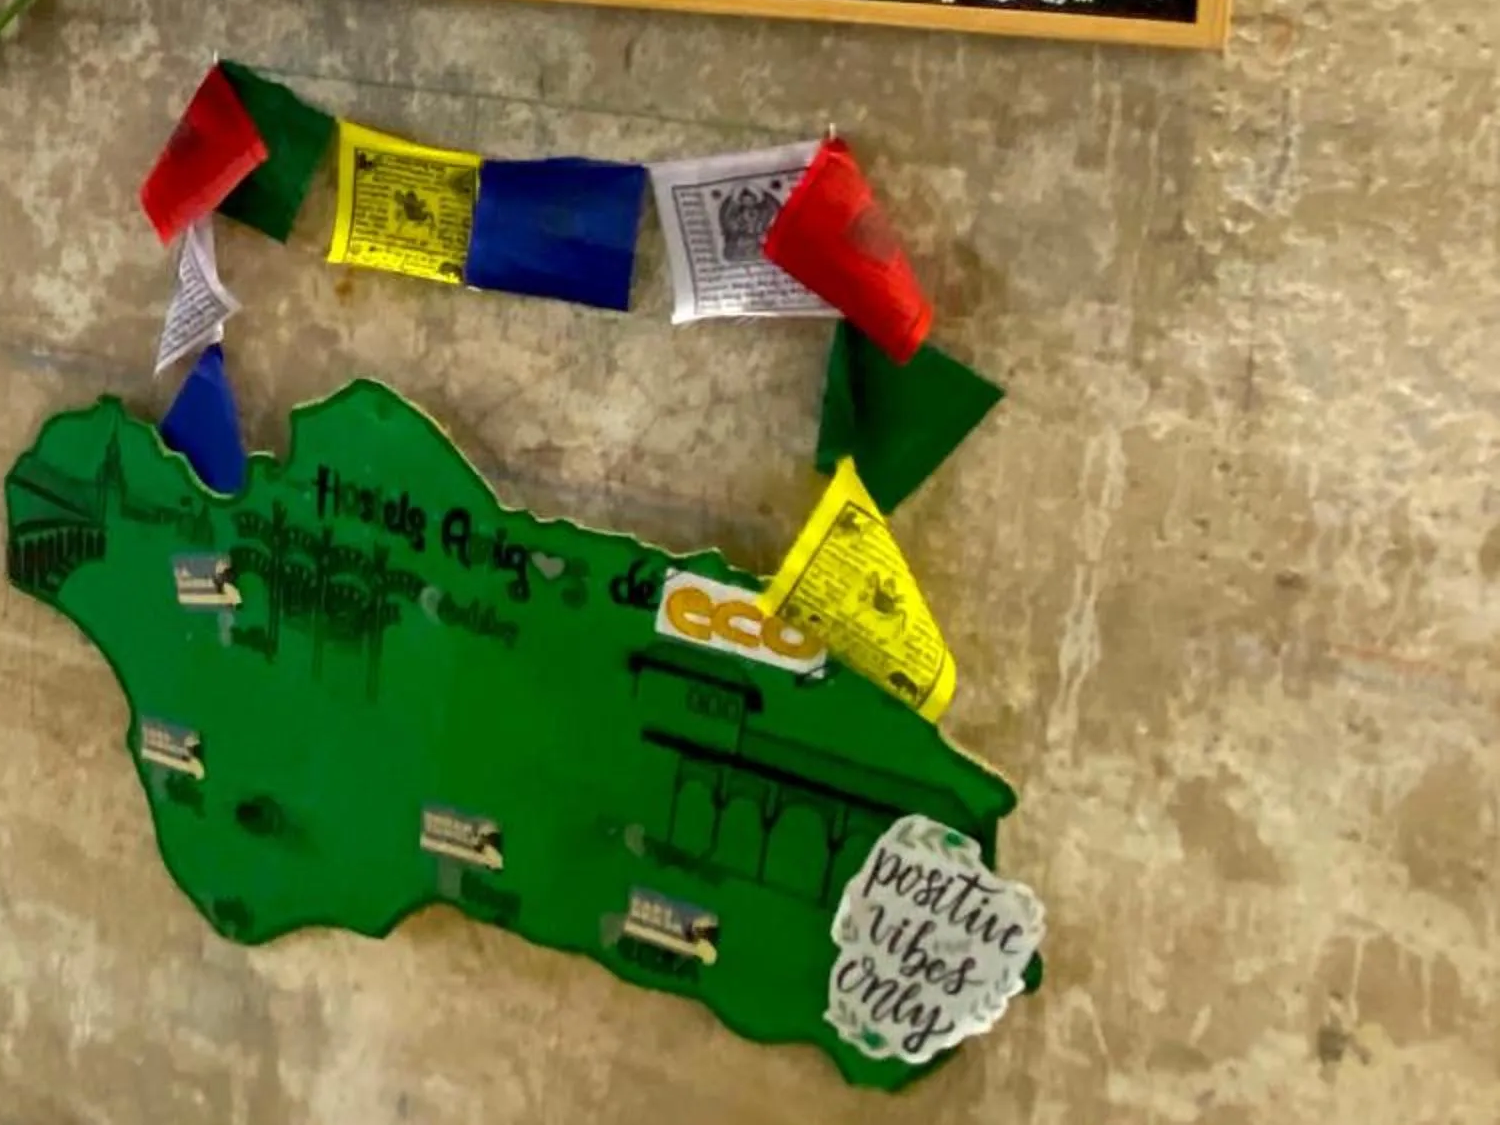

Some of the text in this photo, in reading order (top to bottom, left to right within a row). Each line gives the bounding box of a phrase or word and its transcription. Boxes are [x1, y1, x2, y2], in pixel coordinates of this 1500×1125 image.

[862, 847, 1024, 955] positive
[869, 903, 986, 996] vibes
[836, 956, 957, 1054] only
